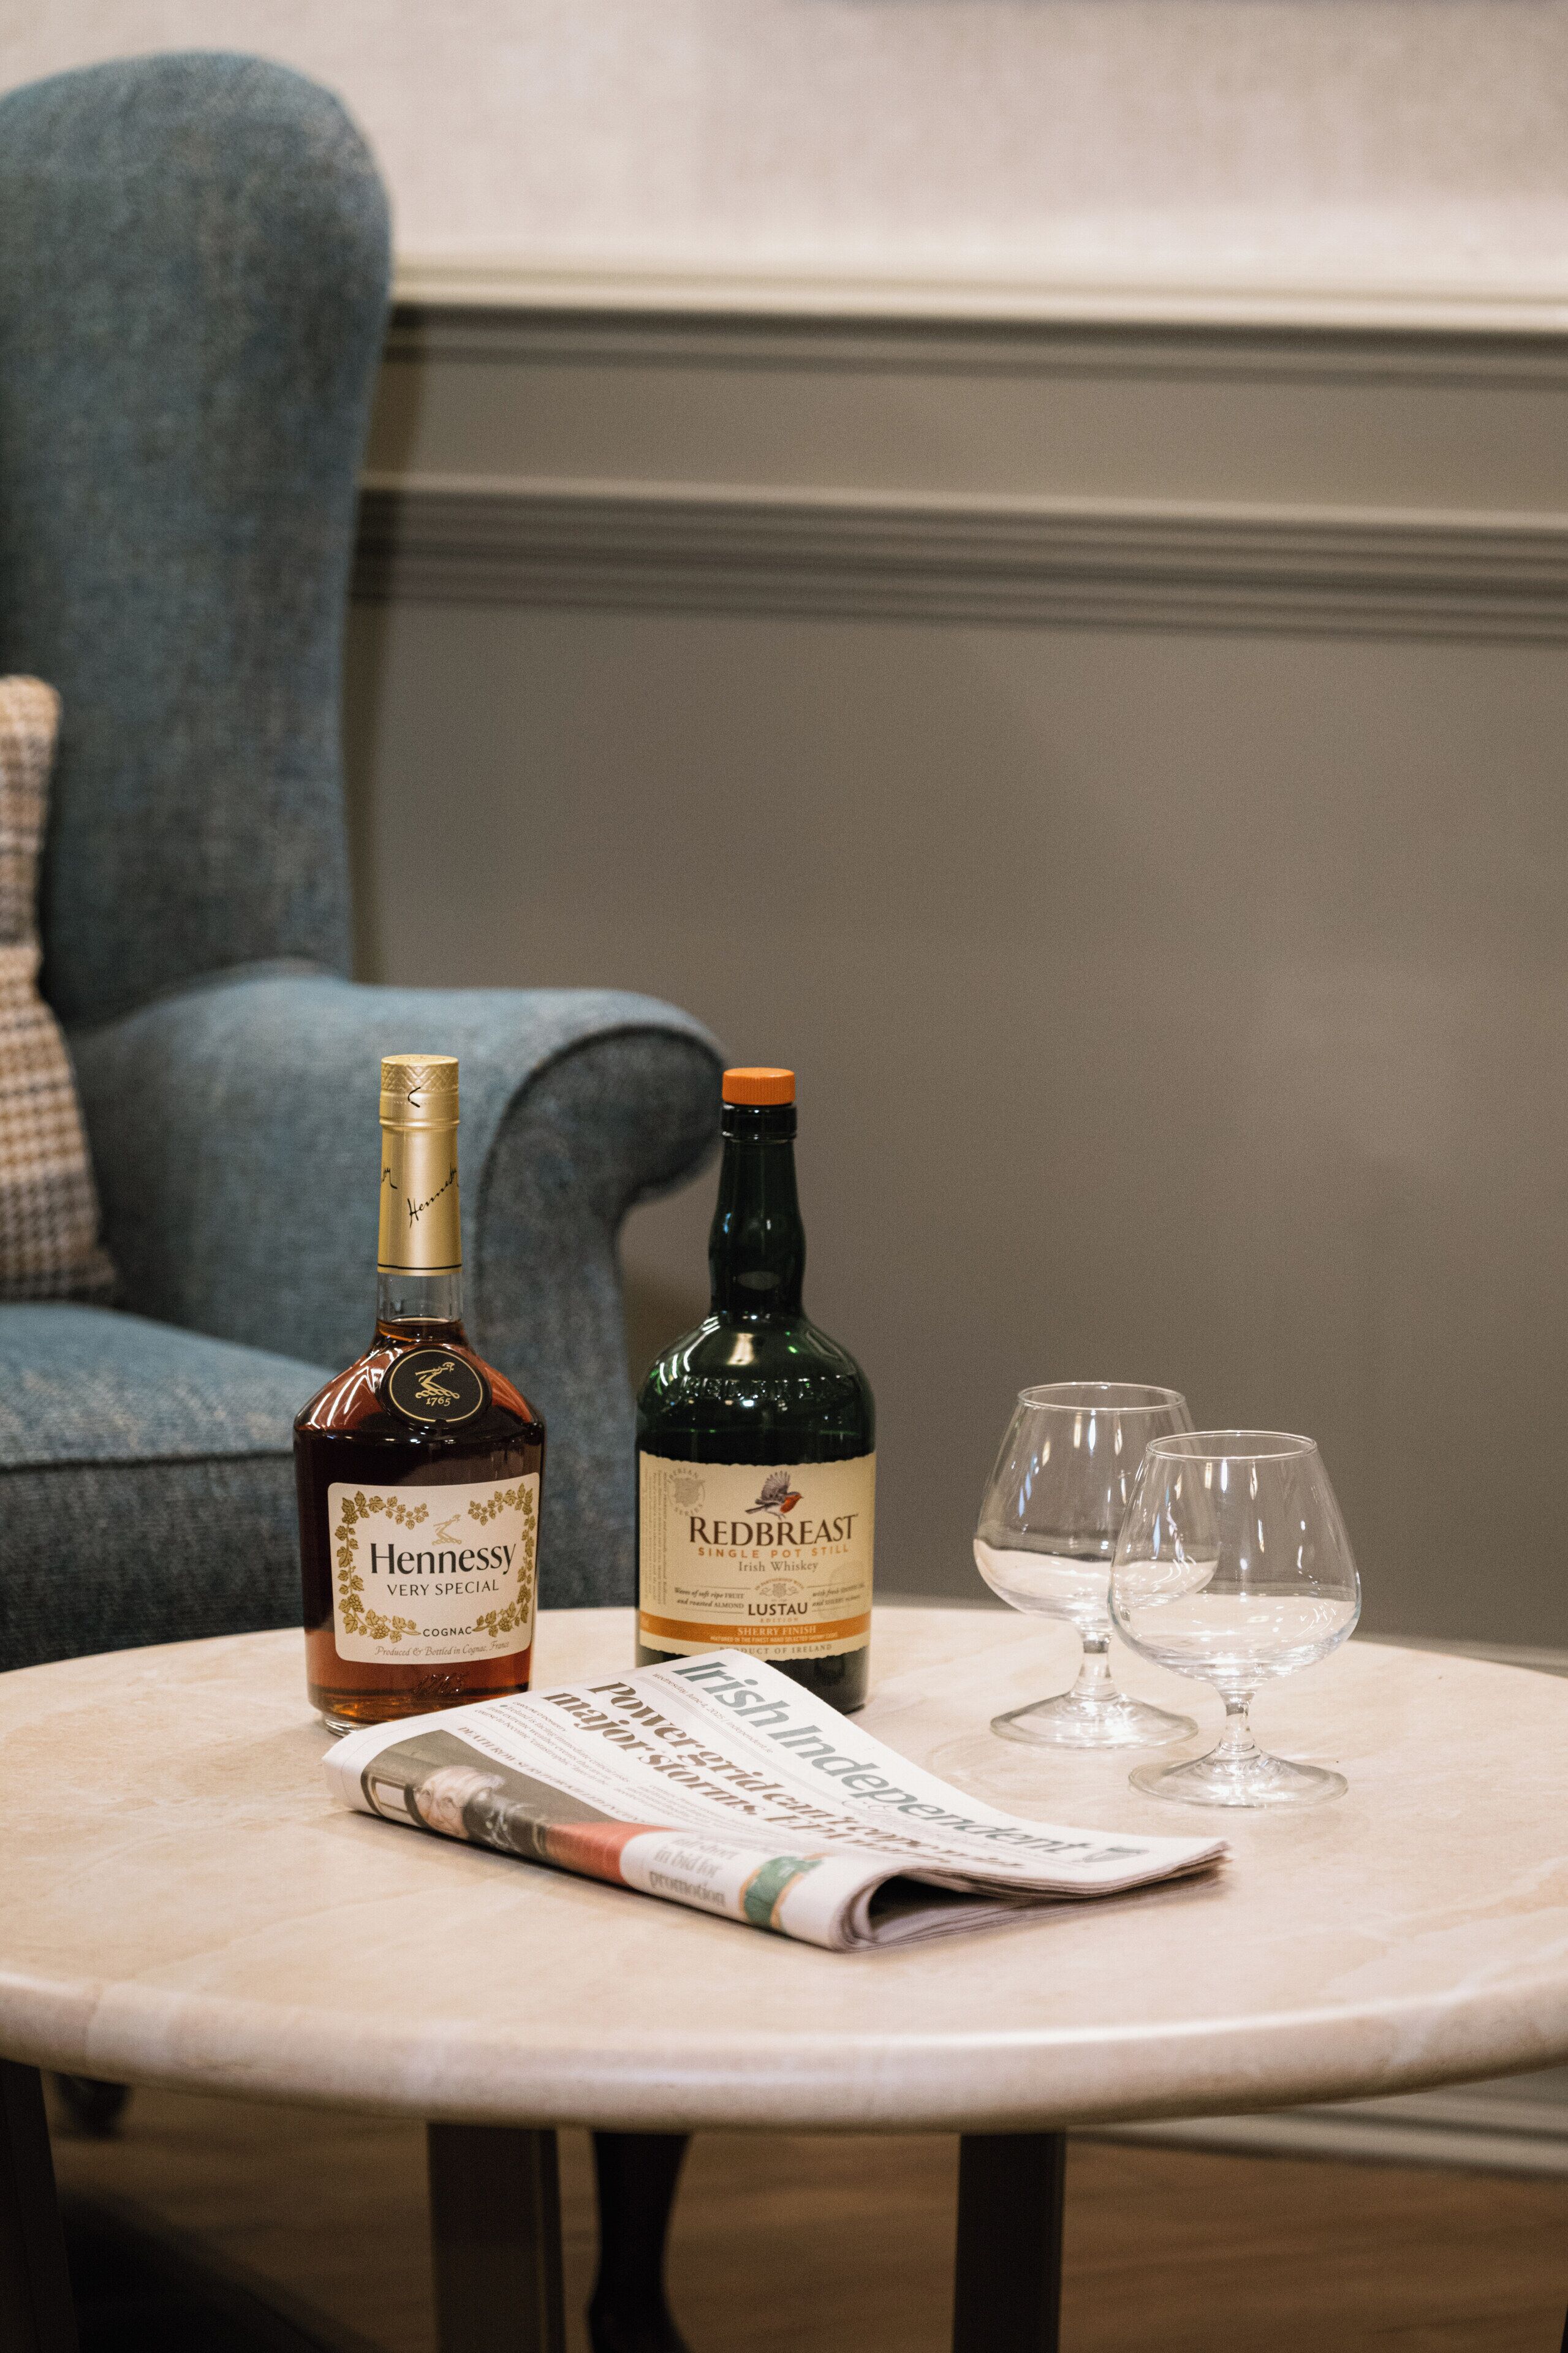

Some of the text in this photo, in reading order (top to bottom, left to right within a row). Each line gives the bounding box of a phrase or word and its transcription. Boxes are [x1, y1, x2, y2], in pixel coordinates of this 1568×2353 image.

[426, 1396, 451, 1407] 1765
[690, 1514, 858, 1546] REDBREAST
[370, 1543, 516, 1575] Hennessy
[698, 1544, 849, 1558] SINGLE POT STILL
[738, 1560, 818, 1573] Irish Whiskey
[387, 1579, 499, 1596] VERY SPECIAL
[748, 1602, 808, 1616] LUSTAU
[423, 1626, 472, 1637] COGNAC
[737, 1626, 817, 1635] SHERRY FINISH
[374, 1646, 410, 1656] Produced
[424, 1646, 452, 1656] Bottled
[489, 1640, 510, 1651] France
[792, 1644, 832, 1654] IRELAND
[458, 1727, 494, 1748] DEATH
[540, 1692, 656, 1752] major
[638, 1754, 767, 1816] storms,
[672, 1661, 790, 1727] Irish
[767, 1725, 1095, 1855] Independent
[585, 1682, 706, 1749] Power
[676, 1751, 786, 1792] grid
[846, 1826, 940, 1850] cope
[649, 1870, 727, 1907] promotion
